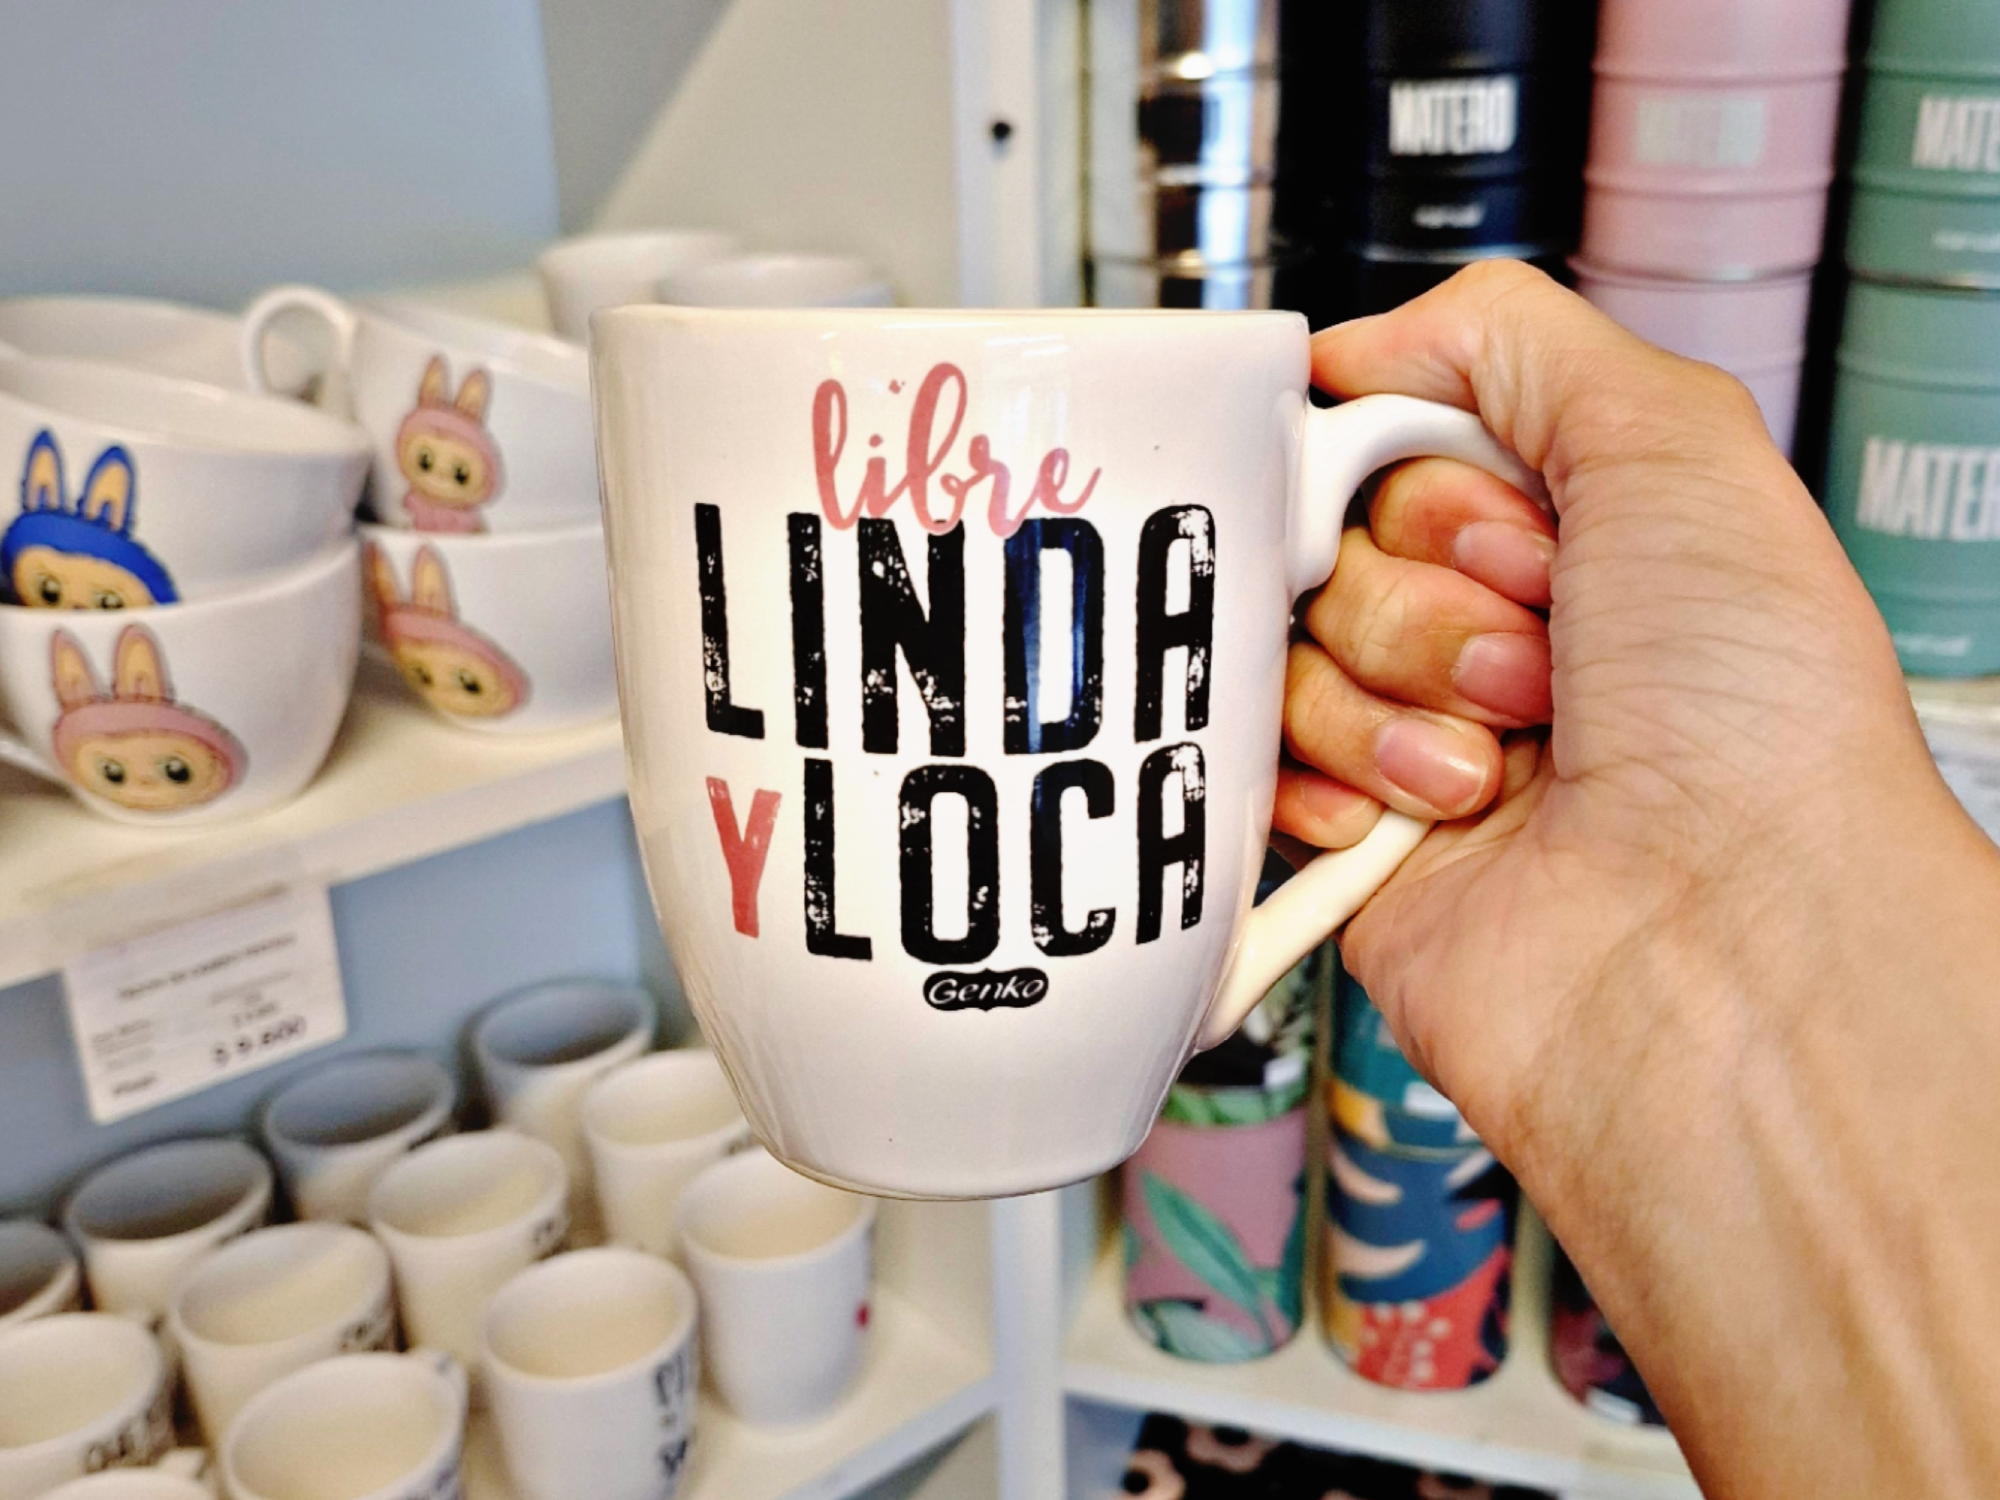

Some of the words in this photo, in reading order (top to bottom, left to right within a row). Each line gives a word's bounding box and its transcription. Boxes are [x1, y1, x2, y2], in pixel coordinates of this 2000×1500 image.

[811, 361, 1101, 538] libre
[694, 501, 1216, 757] LINDA
[706, 775, 783, 939] Y
[803, 741, 1207, 965] LOCA
[928, 974, 1045, 1005] Genko
